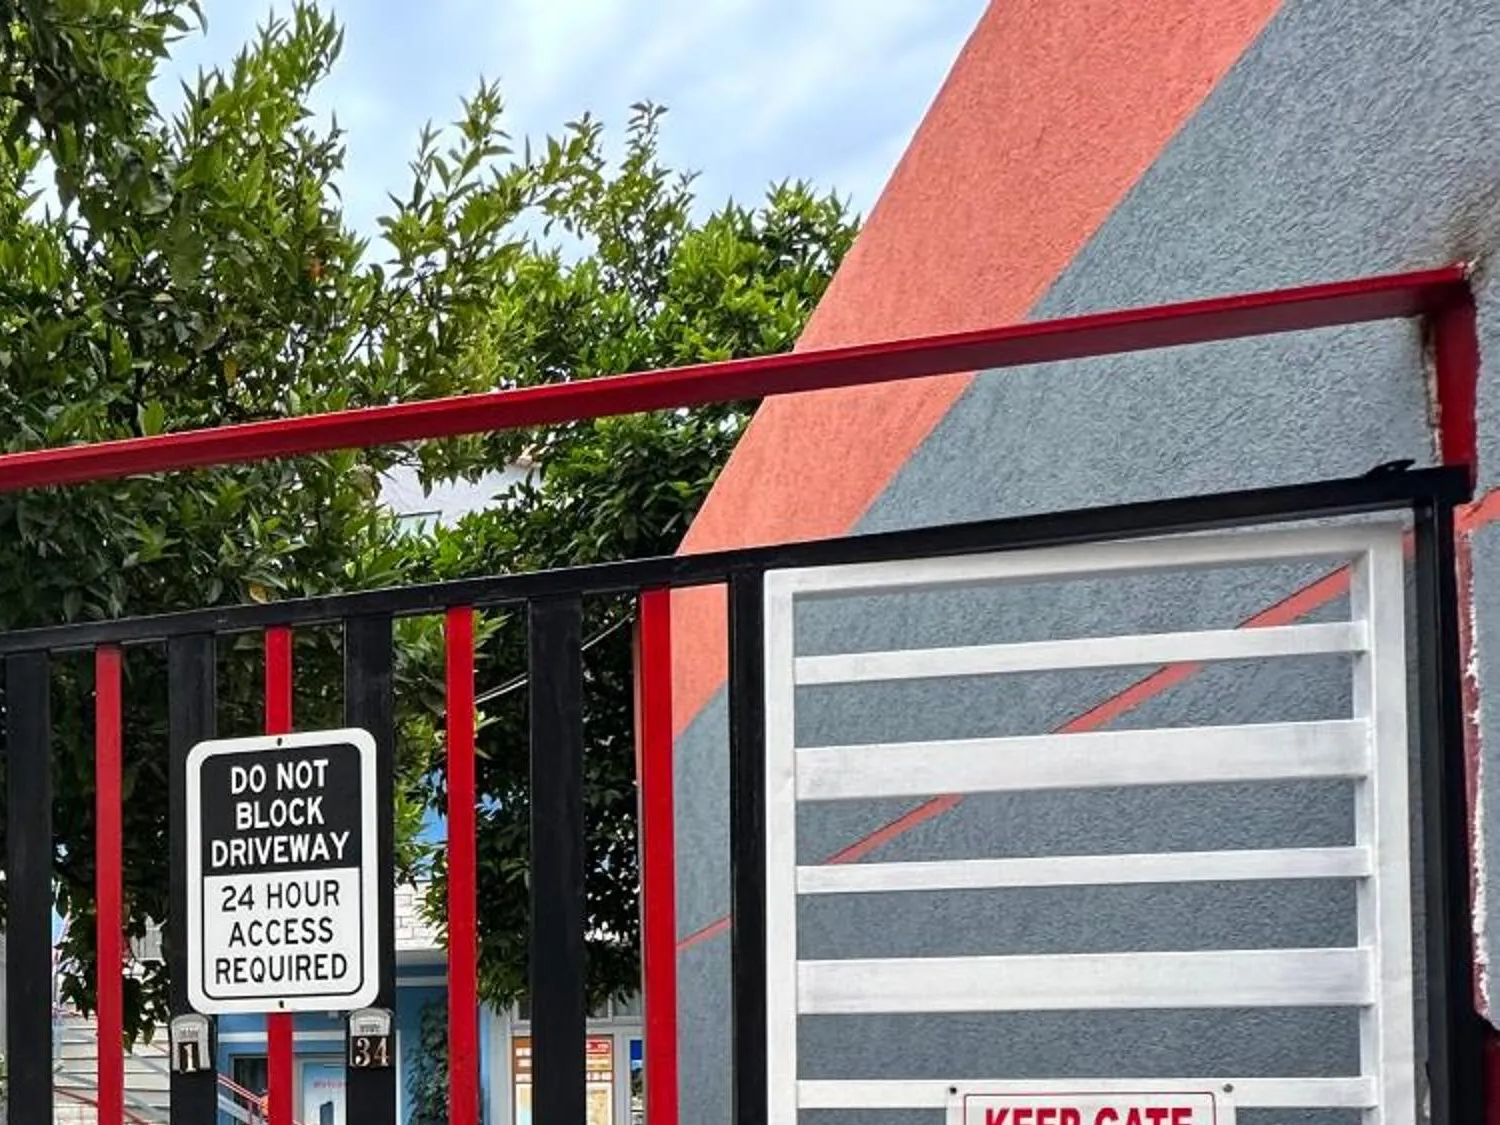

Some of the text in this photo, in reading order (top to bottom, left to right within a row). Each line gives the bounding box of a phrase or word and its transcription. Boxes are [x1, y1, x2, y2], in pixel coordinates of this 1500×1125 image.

[231, 759, 329, 795] DO NOT
[236, 796, 325, 830] BLOCK
[211, 831, 349, 868] DRIVEWAY
[221, 879, 340, 913] 24 HOUR
[228, 917, 333, 948] ACCESS
[215, 953, 348, 985] REQUIRED
[183, 1043, 197, 1073] 1
[355, 1036, 390, 1068] 34
